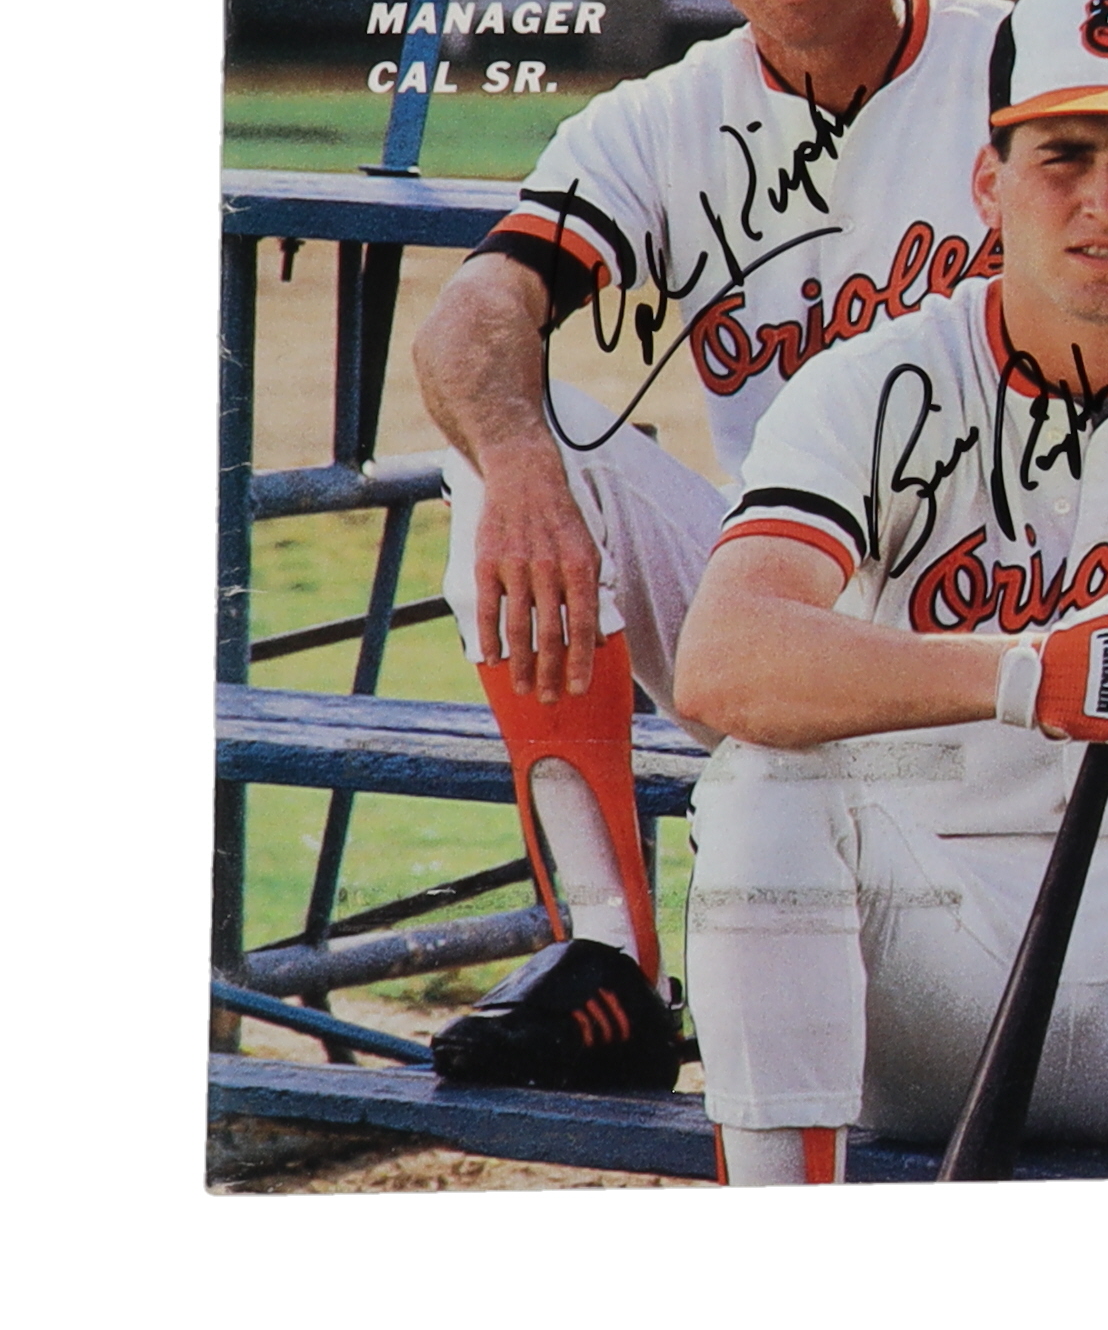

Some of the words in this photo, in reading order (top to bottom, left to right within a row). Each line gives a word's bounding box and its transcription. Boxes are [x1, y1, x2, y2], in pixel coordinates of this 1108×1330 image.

[367, 0, 607, 35] MANAGER
[368, 60, 458, 94] CAL
[483, 61, 558, 93] SR.
